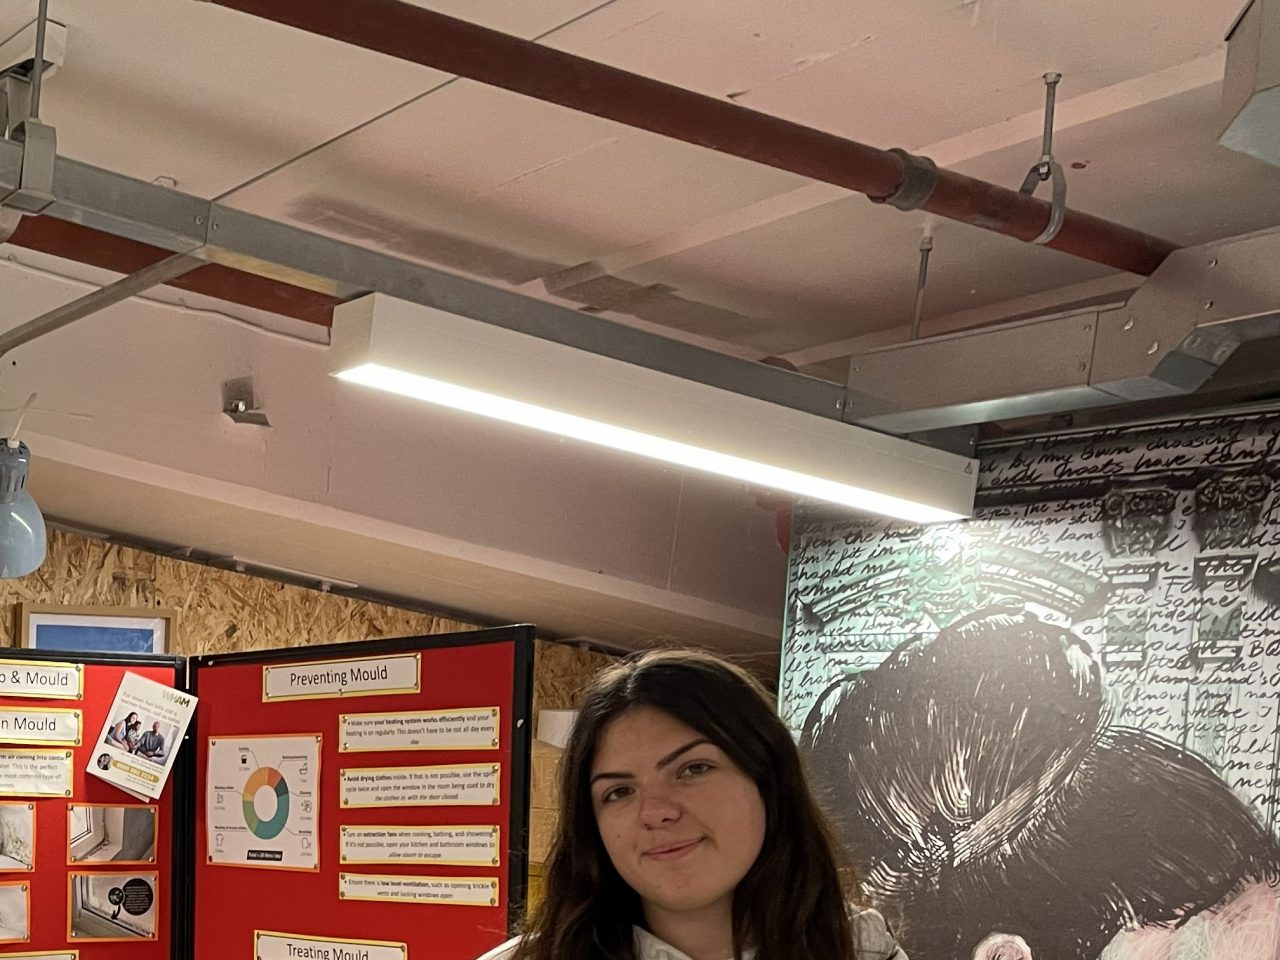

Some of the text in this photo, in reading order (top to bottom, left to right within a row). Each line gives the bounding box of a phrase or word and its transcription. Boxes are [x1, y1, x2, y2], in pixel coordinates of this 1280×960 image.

[10, 669, 22, 685] &
[25, 669, 69, 687] Mould
[289, 664, 388, 687] Preventing Mould
[13, 715, 57, 733] Mould
[374, 719, 385, 727] your
[438, 715, 466, 723] efficiently
[42, 774, 54, 782] type
[360, 775, 375, 783] drying
